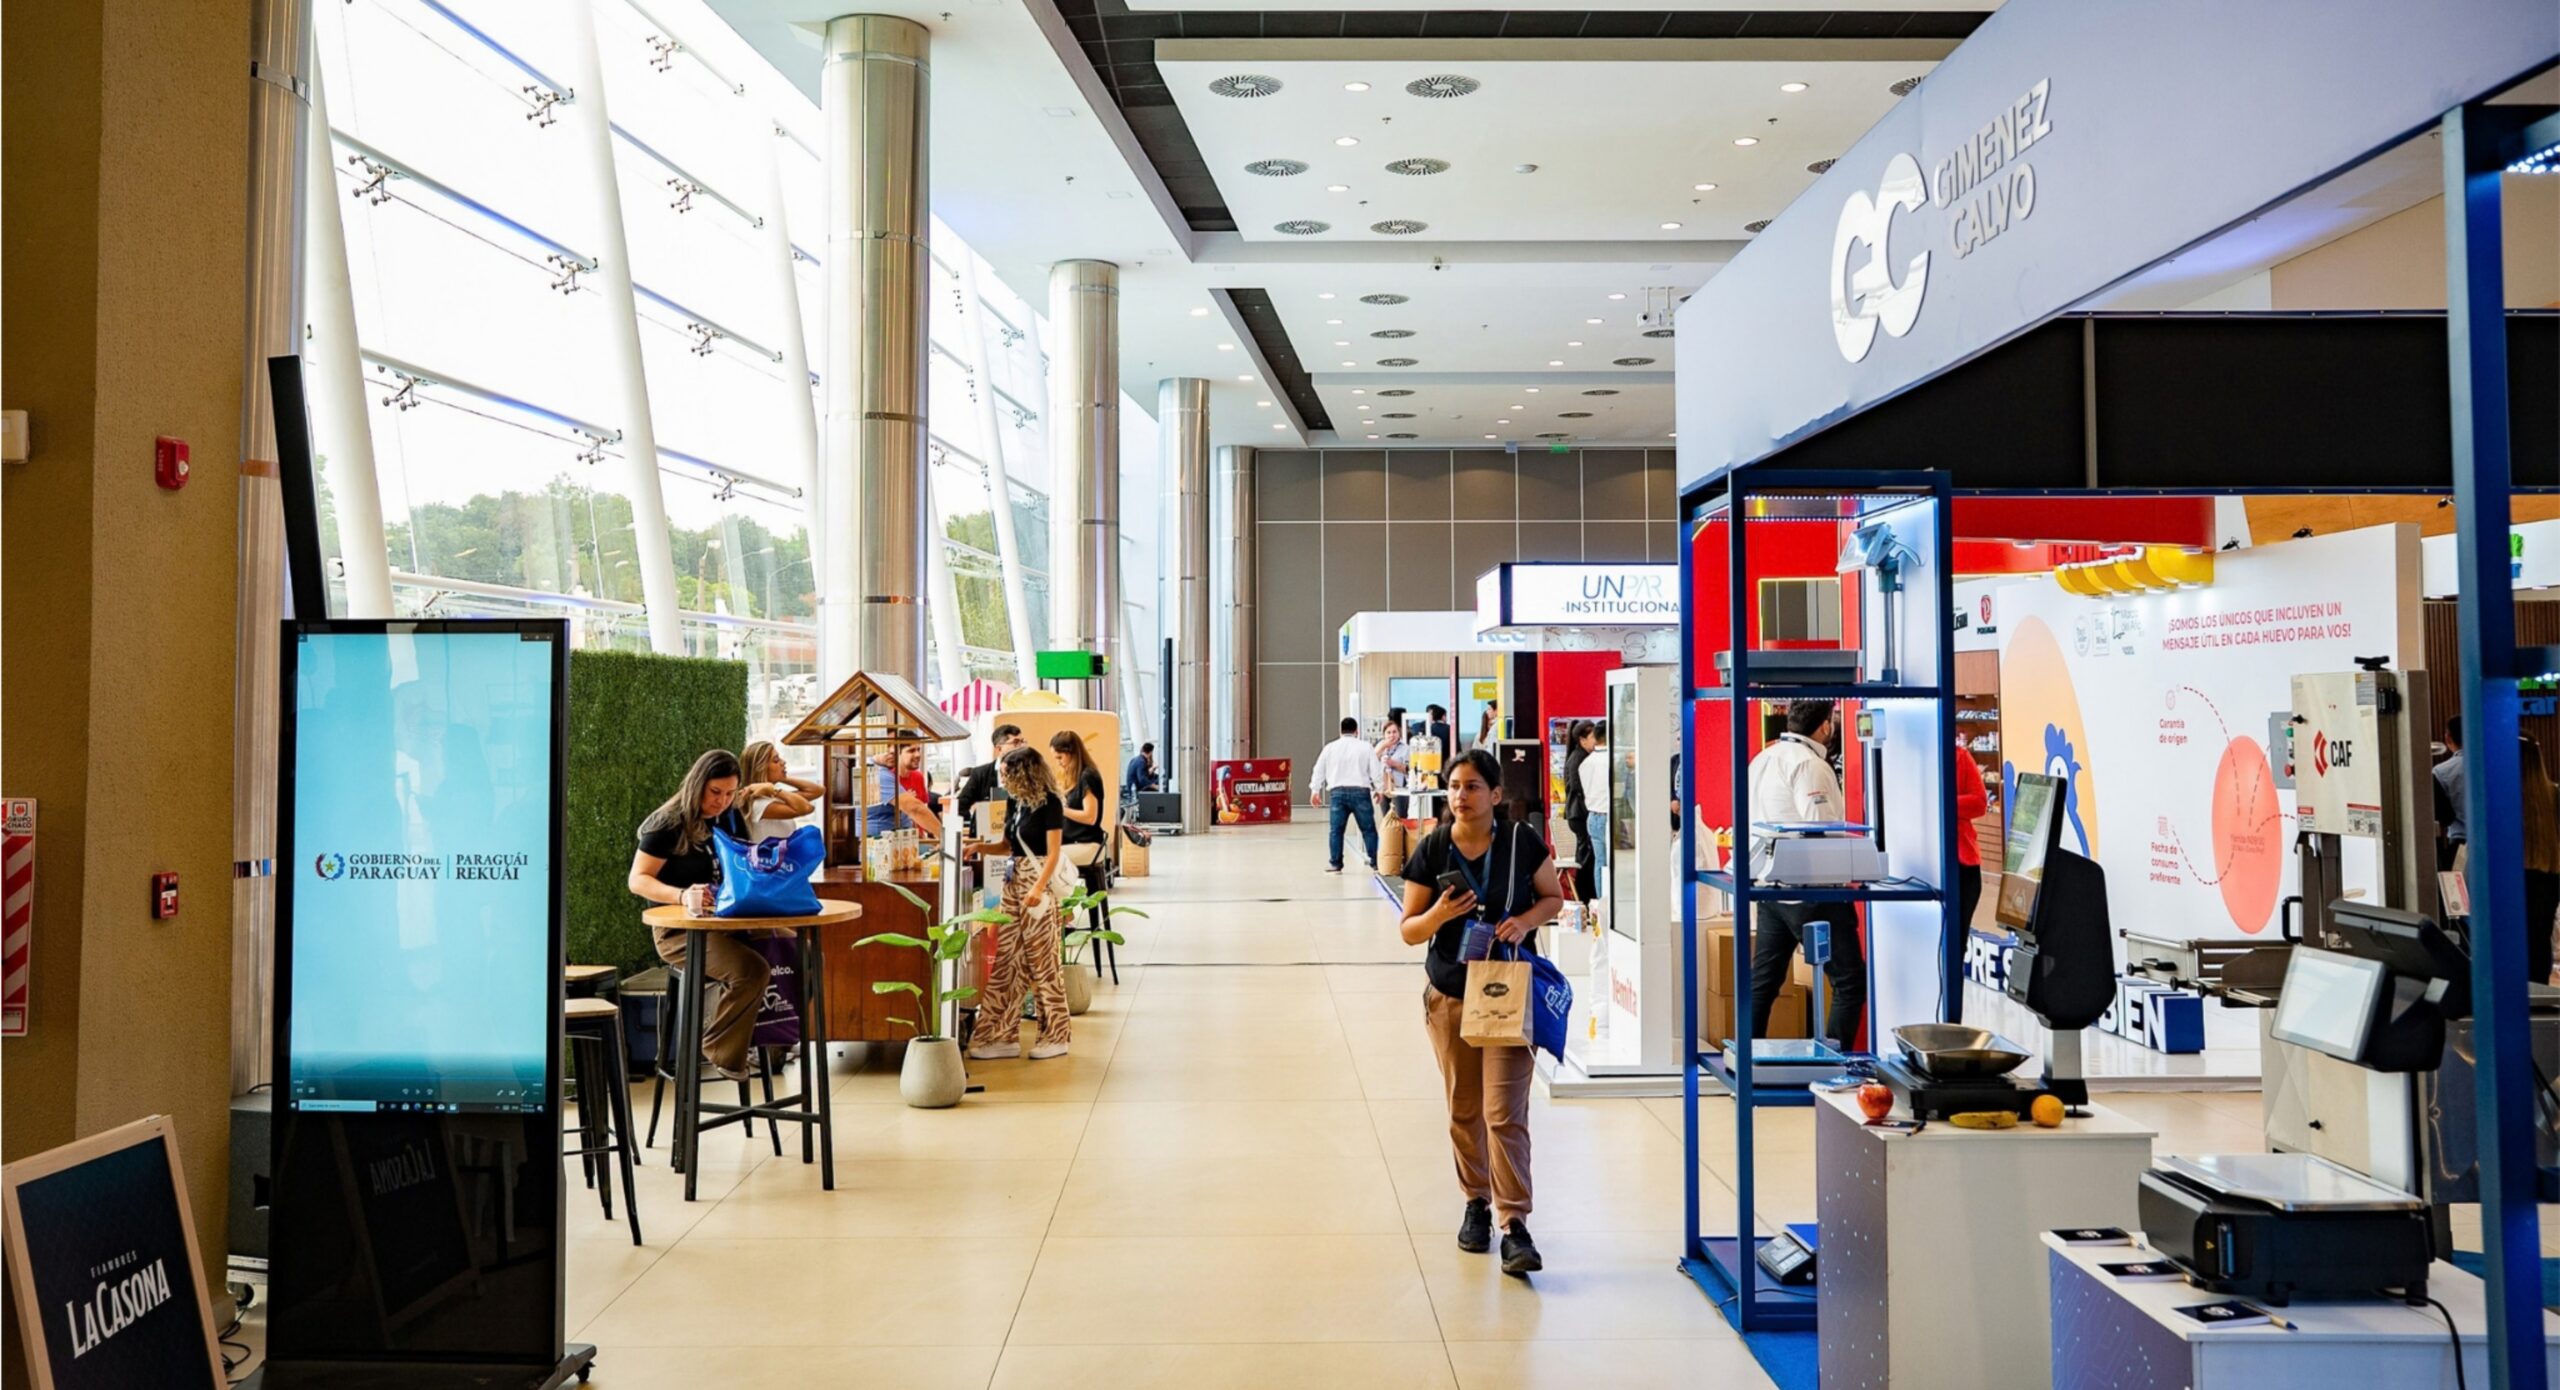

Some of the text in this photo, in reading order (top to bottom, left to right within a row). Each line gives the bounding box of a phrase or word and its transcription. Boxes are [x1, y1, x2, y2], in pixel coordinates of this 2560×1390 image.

[1933, 77, 2053, 210] GIMENEZ
[1952, 162, 2036, 260] CALVO
[1583, 575, 1662, 599] UNPAR
[2201, 614, 2217, 629] LOS
[2219, 611, 2252, 627] ÚNICOS
[2254, 609, 2273, 625] QUE
[2275, 603, 2325, 622] INCLUYEN
[2328, 602, 2342, 616] UN
[2162, 623, 2351, 650] MENSAJE ÚTIL EN CADA HUEVO PARA VOS!
[2331, 740, 2352, 767] CAF
[350, 854, 441, 866] GOBIERNO DEL
[350, 866, 441, 880] PARAGUAY
[456, 852, 528, 867] PARAGUÁI
[456, 864, 519, 880] REKUÁI
[2098, 981, 2167, 1053] BIEN
[90, 1249, 138, 1279] FIAMBRES
